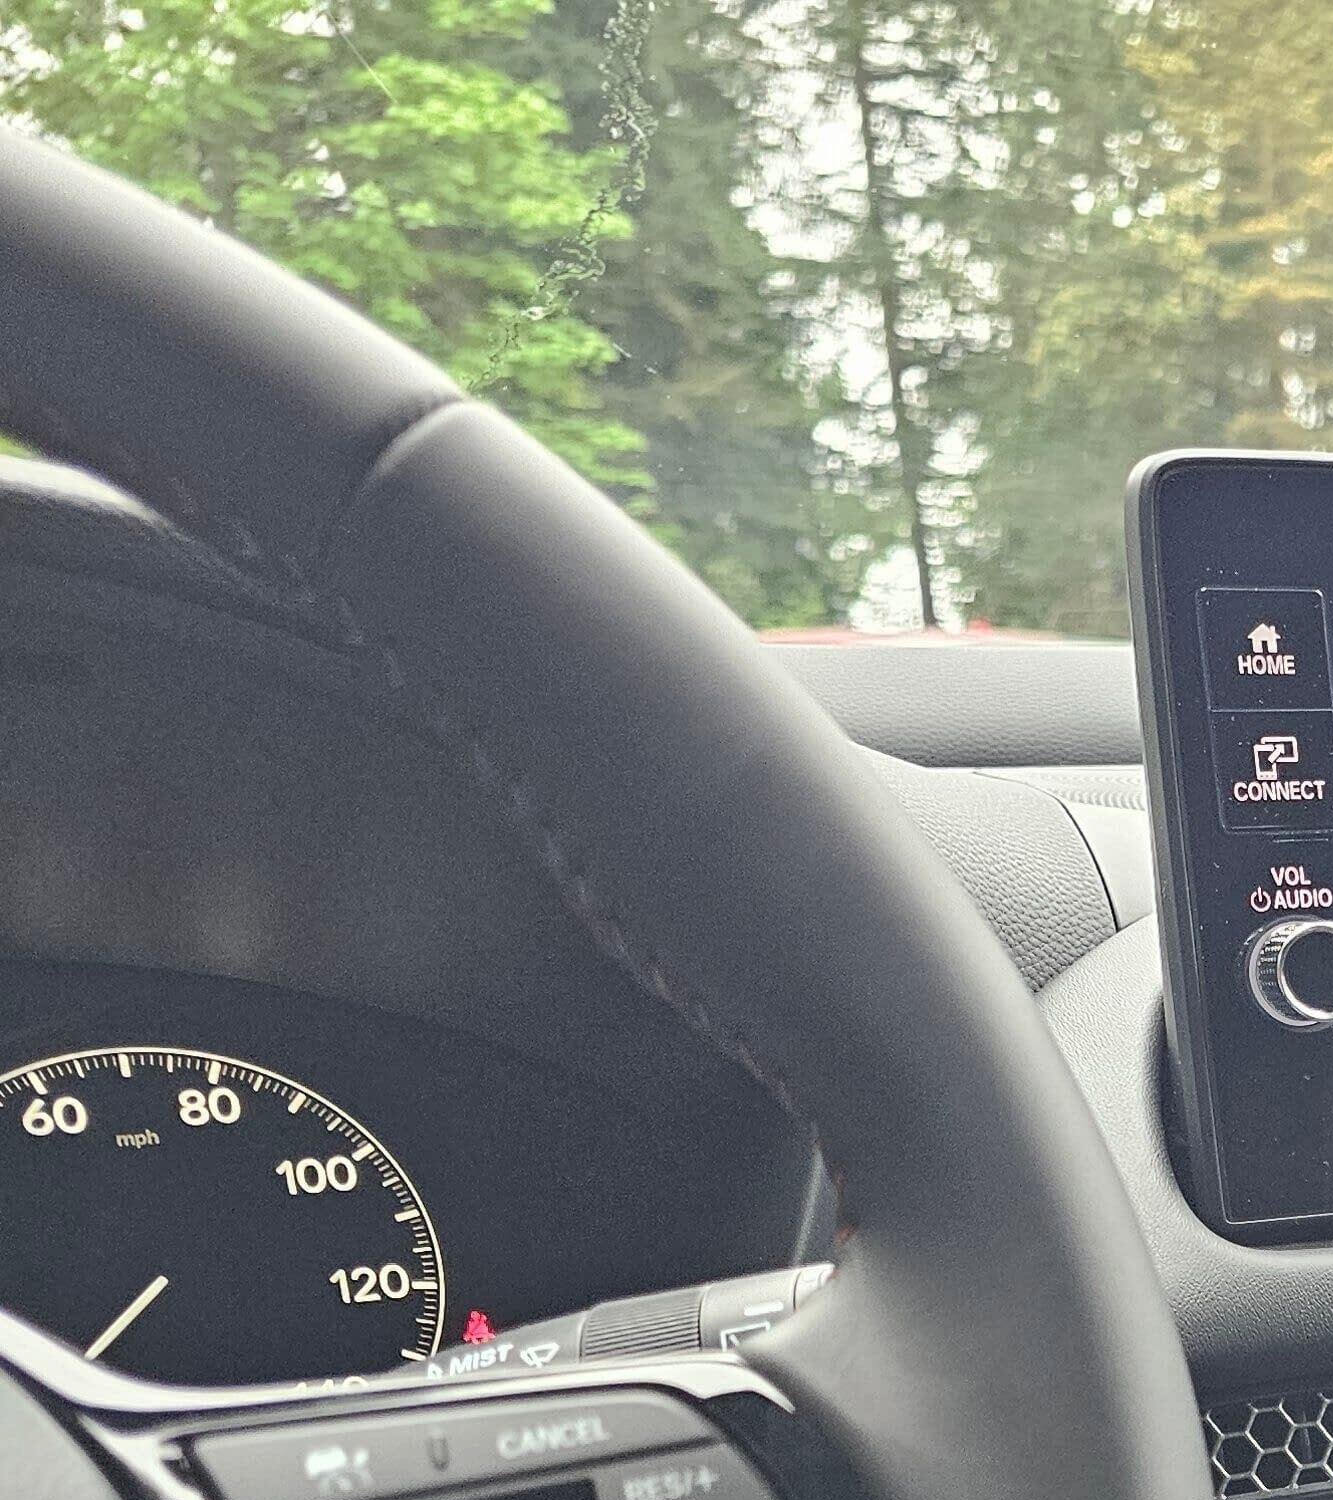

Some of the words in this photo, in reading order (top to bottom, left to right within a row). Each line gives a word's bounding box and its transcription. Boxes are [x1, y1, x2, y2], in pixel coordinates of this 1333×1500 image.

[1237, 653, 1297, 677] HOME
[1233, 779, 1325, 803] CONNECT
[1270, 866, 1312, 887] VOL
[1273, 886, 1333, 910] AUDIO
[22, 1096, 88, 1137] 60
[177, 1087, 242, 1127] 80
[115, 1130, 160, 1149] mph
[275, 1155, 359, 1196] 100
[329, 1263, 411, 1304] 120
[450, 1343, 514, 1376] MIST
[497, 1416, 611, 1458] CANCEL
